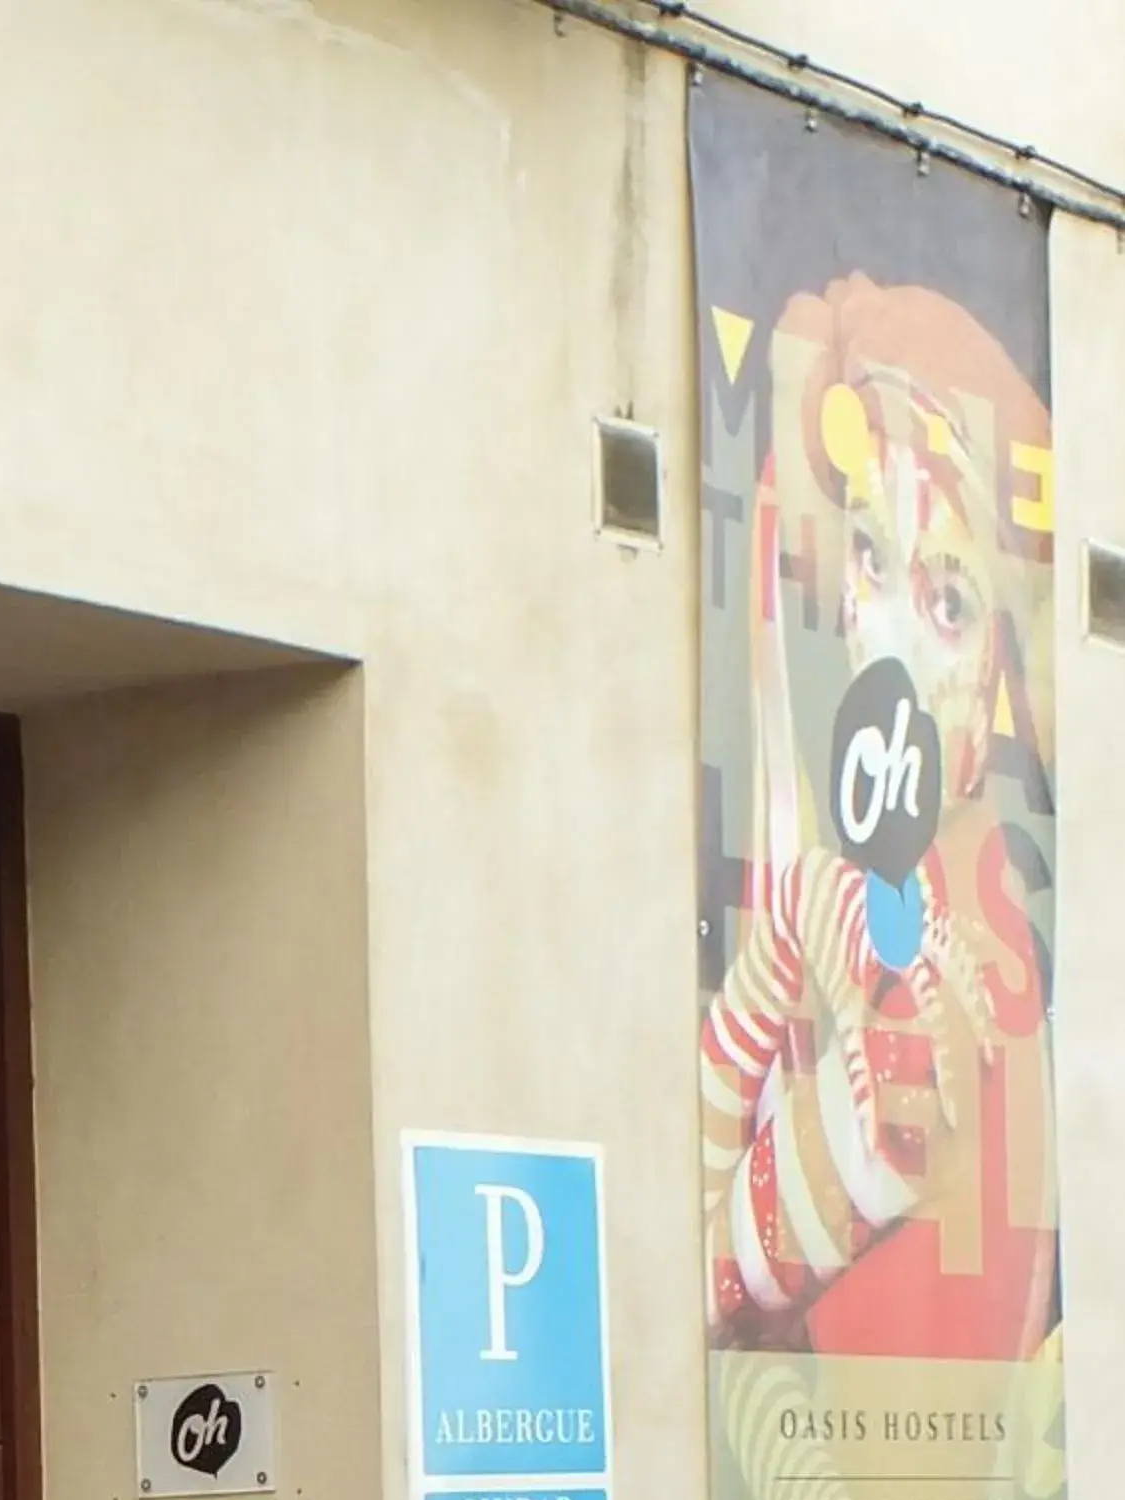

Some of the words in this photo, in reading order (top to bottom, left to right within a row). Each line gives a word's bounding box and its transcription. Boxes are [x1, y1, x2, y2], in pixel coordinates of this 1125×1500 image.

[474, 1183, 545, 1361] P
[434, 1408, 595, 1445] ALBERGUE
[779, 1408, 867, 1441] OASIS
[883, 1410, 1008, 1443] HOSTELS
